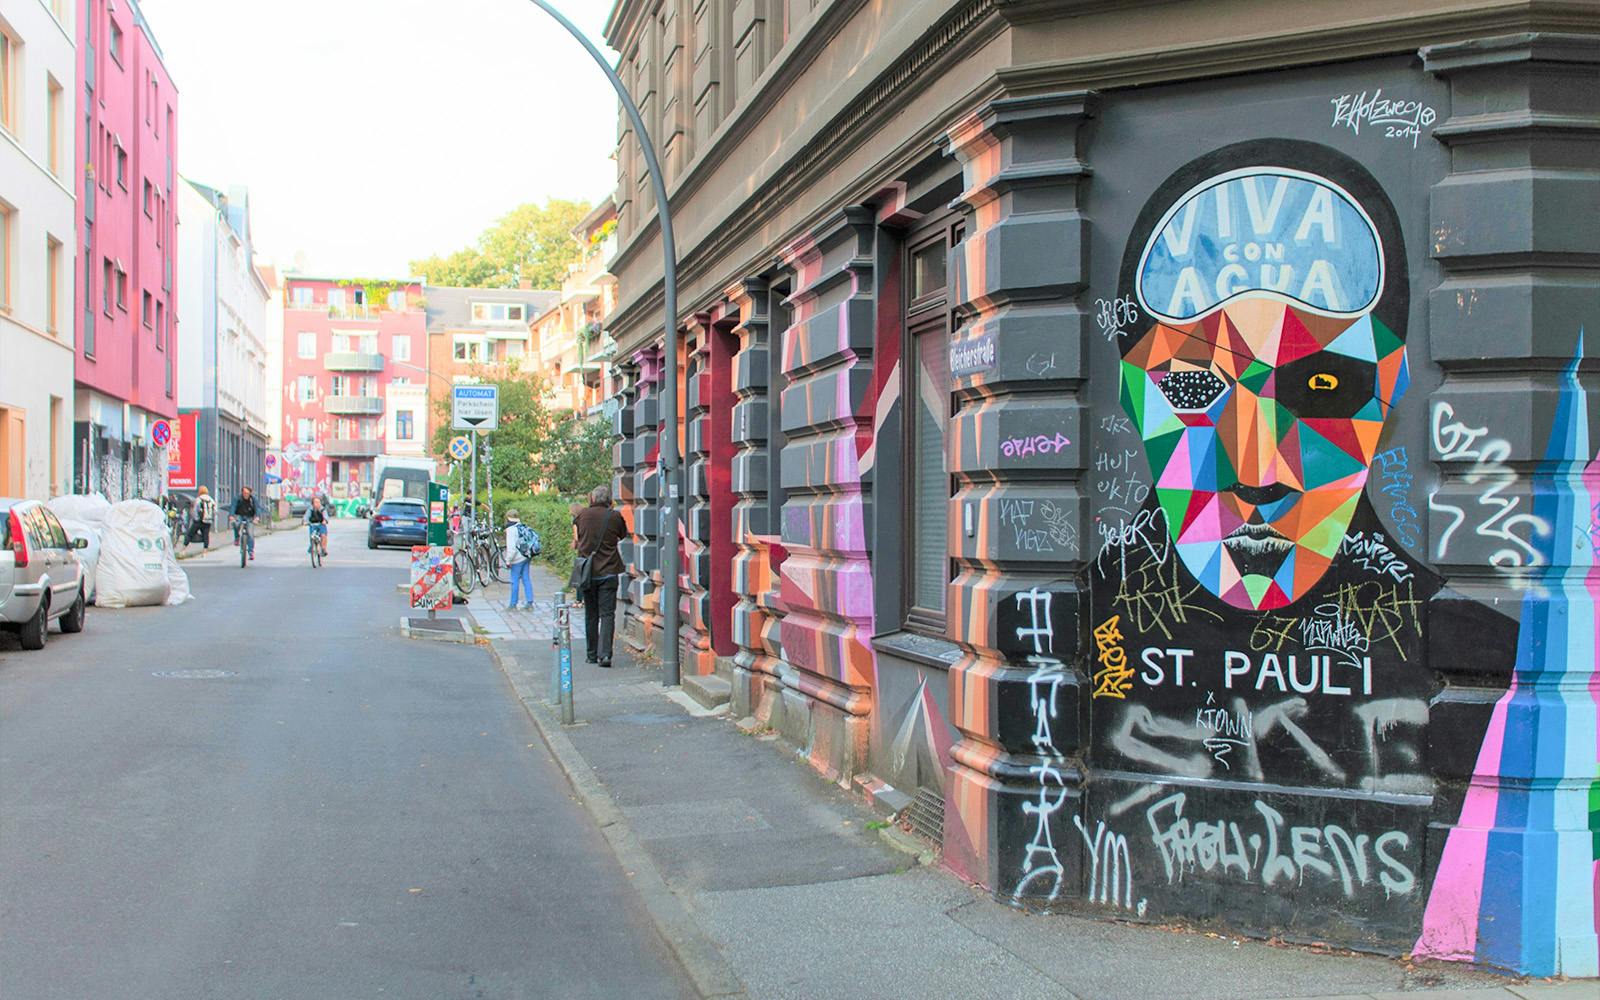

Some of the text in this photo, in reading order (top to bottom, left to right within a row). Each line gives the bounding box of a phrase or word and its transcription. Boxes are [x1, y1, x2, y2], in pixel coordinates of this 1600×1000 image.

[1385, 124, 1421, 149] 2014
[1162, 176, 1339, 257] VIVA
[1223, 241, 1286, 262] CON
[1166, 260, 1341, 315] AGUA
[458, 389, 493, 397] AUTOMAT
[1141, 647, 1197, 688] ST.
[1224, 650, 1373, 696] PAULI
